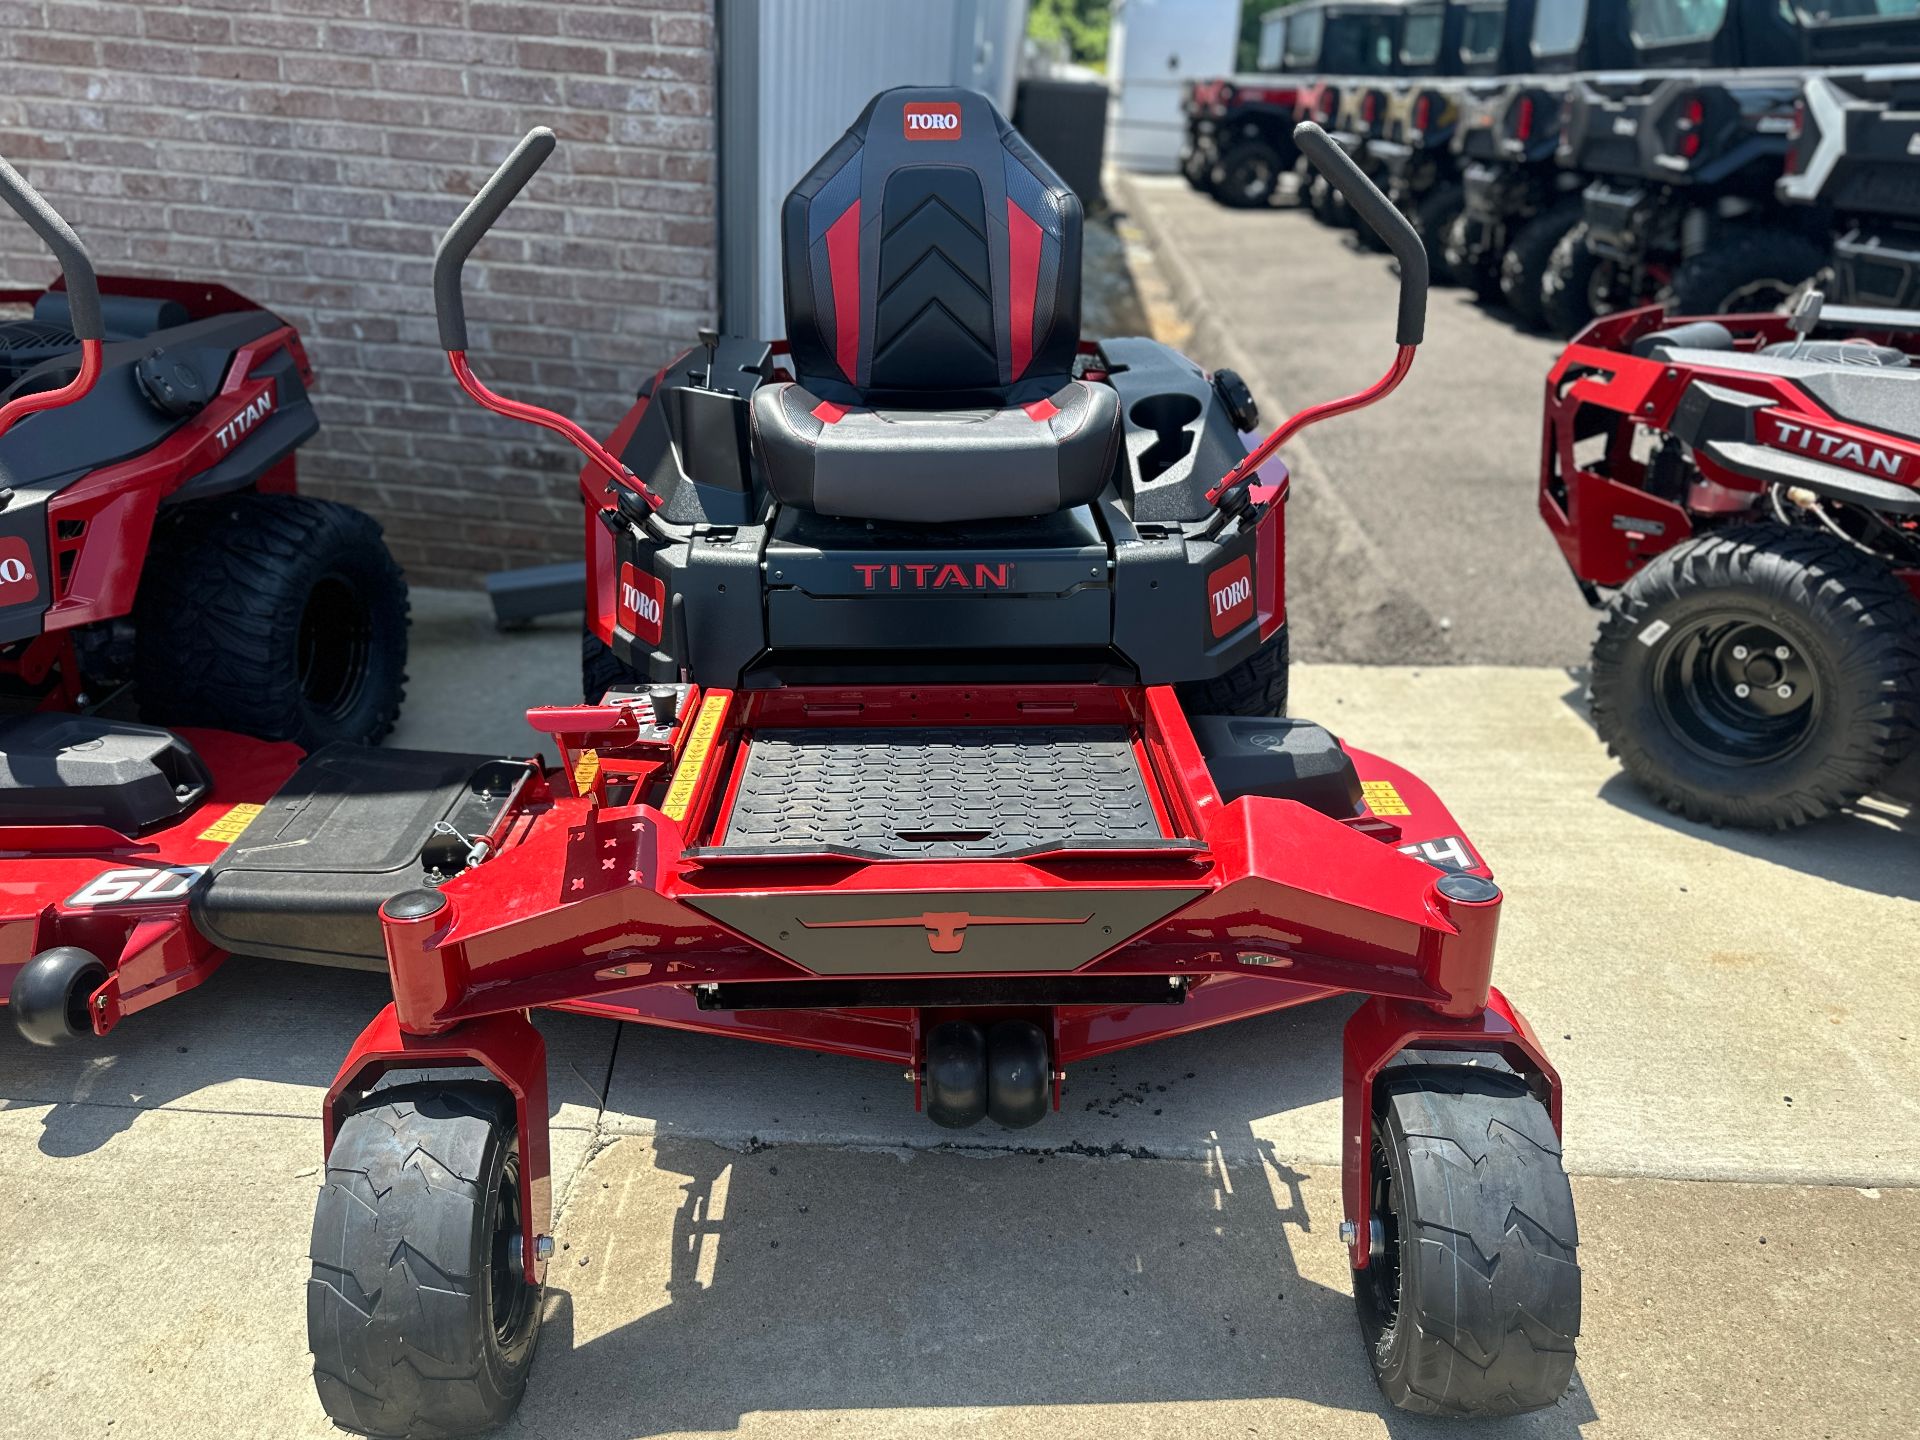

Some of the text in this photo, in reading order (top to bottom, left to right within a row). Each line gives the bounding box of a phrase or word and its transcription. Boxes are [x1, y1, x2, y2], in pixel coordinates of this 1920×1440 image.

[907, 113, 958, 130] TORO
[215, 390, 272, 449] TITAN
[1775, 420, 1903, 476] TITAN
[852, 564, 1009, 590] TITAN
[1212, 576, 1250, 617] TORO
[623, 582, 660, 624] TORO
[68, 865, 210, 905] 60
